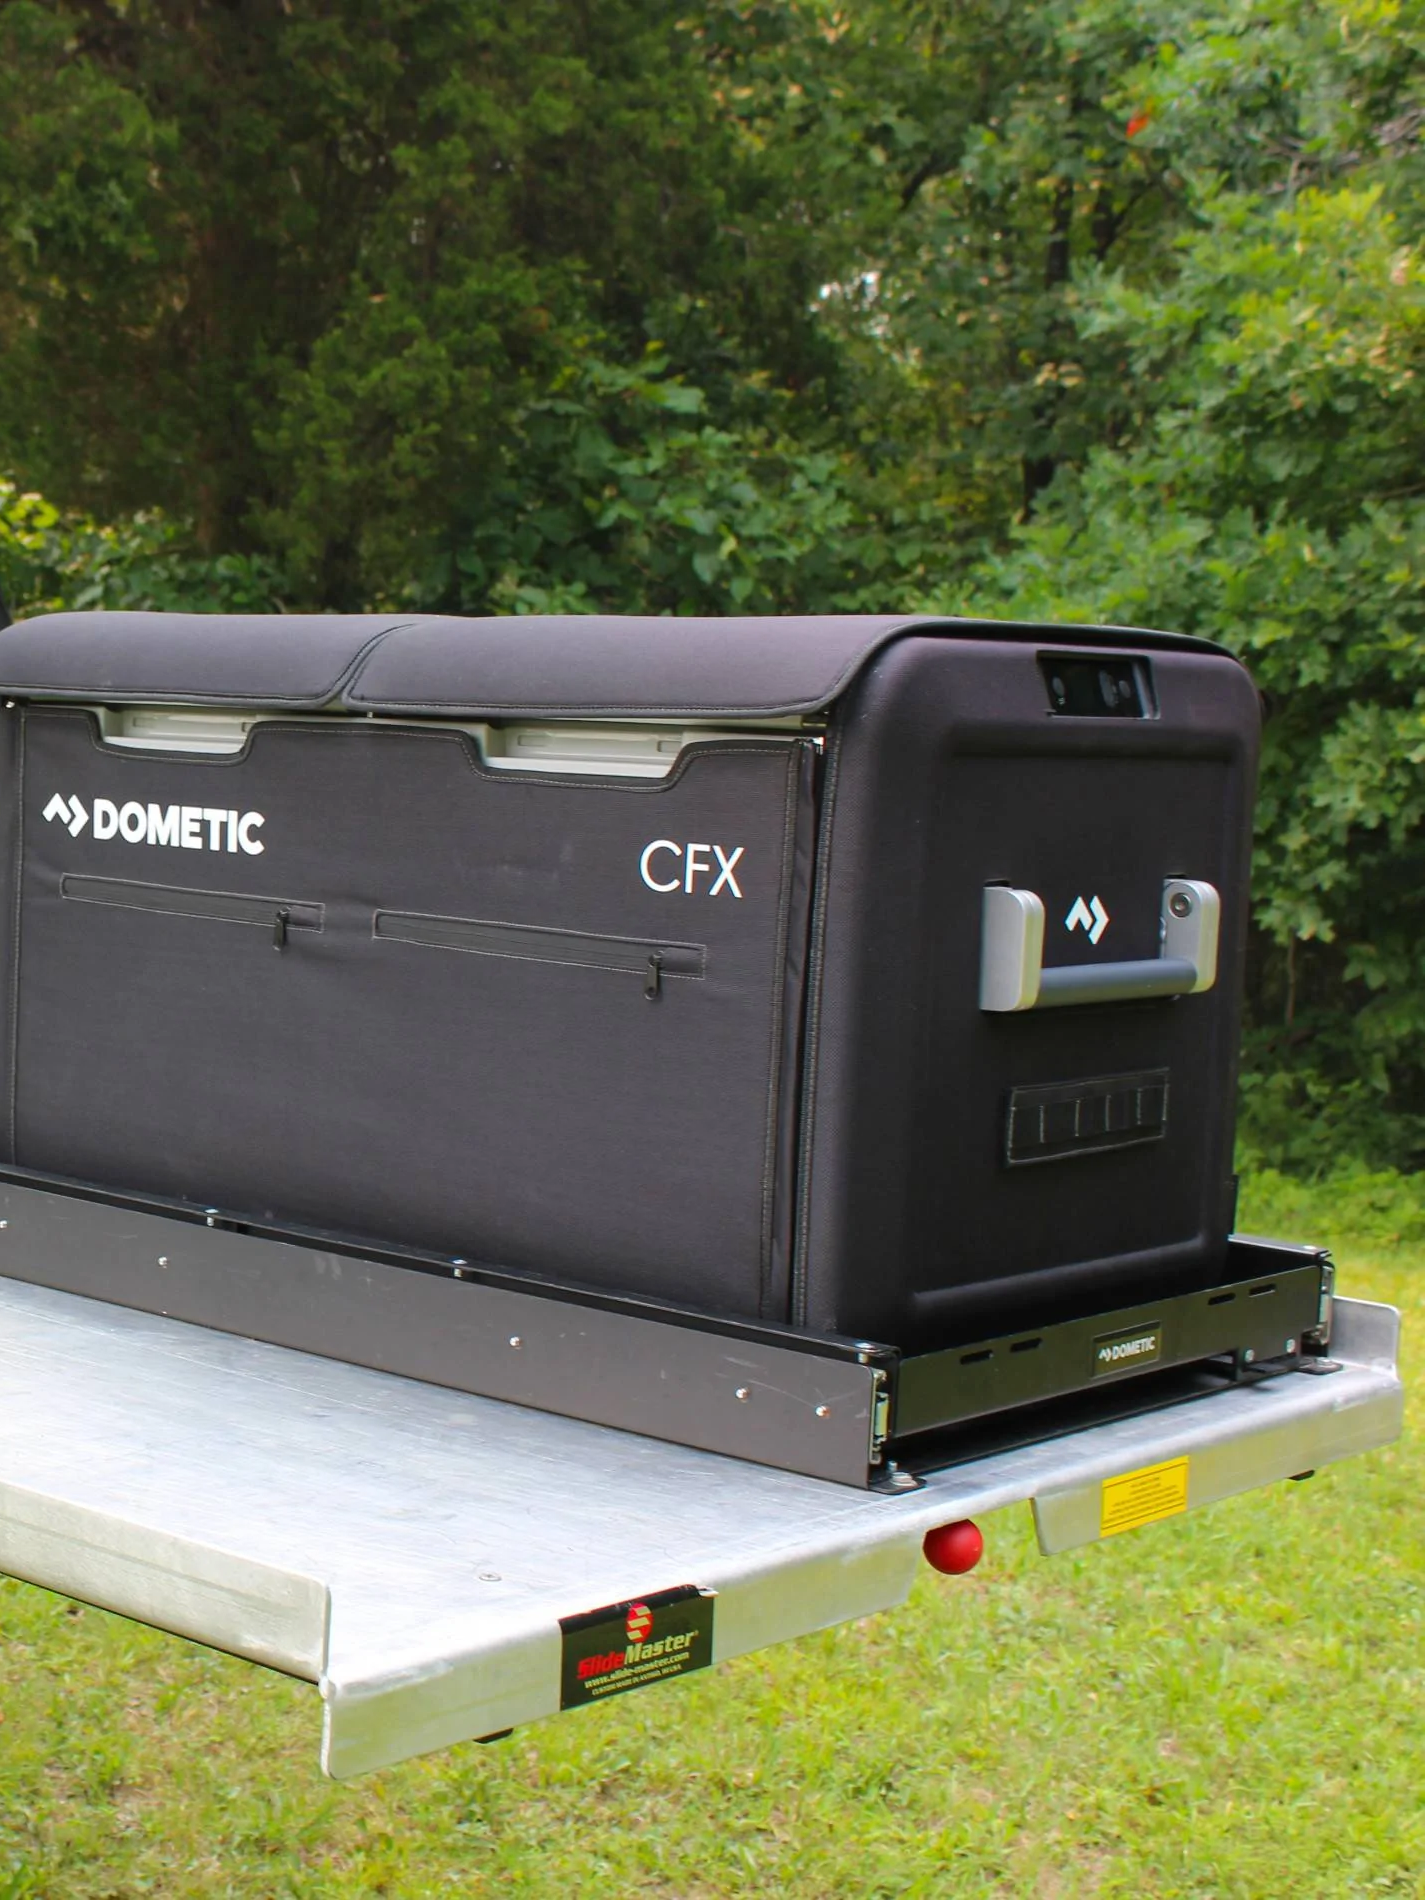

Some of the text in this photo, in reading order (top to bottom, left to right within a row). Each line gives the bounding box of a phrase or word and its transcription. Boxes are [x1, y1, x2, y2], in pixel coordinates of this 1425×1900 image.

[92, 798, 265, 855] DOMETIC
[639, 840, 745, 898] CFX
[1112, 1336, 1156, 1361] DOMETIC
[577, 1631, 695, 1680] SlideMaster
